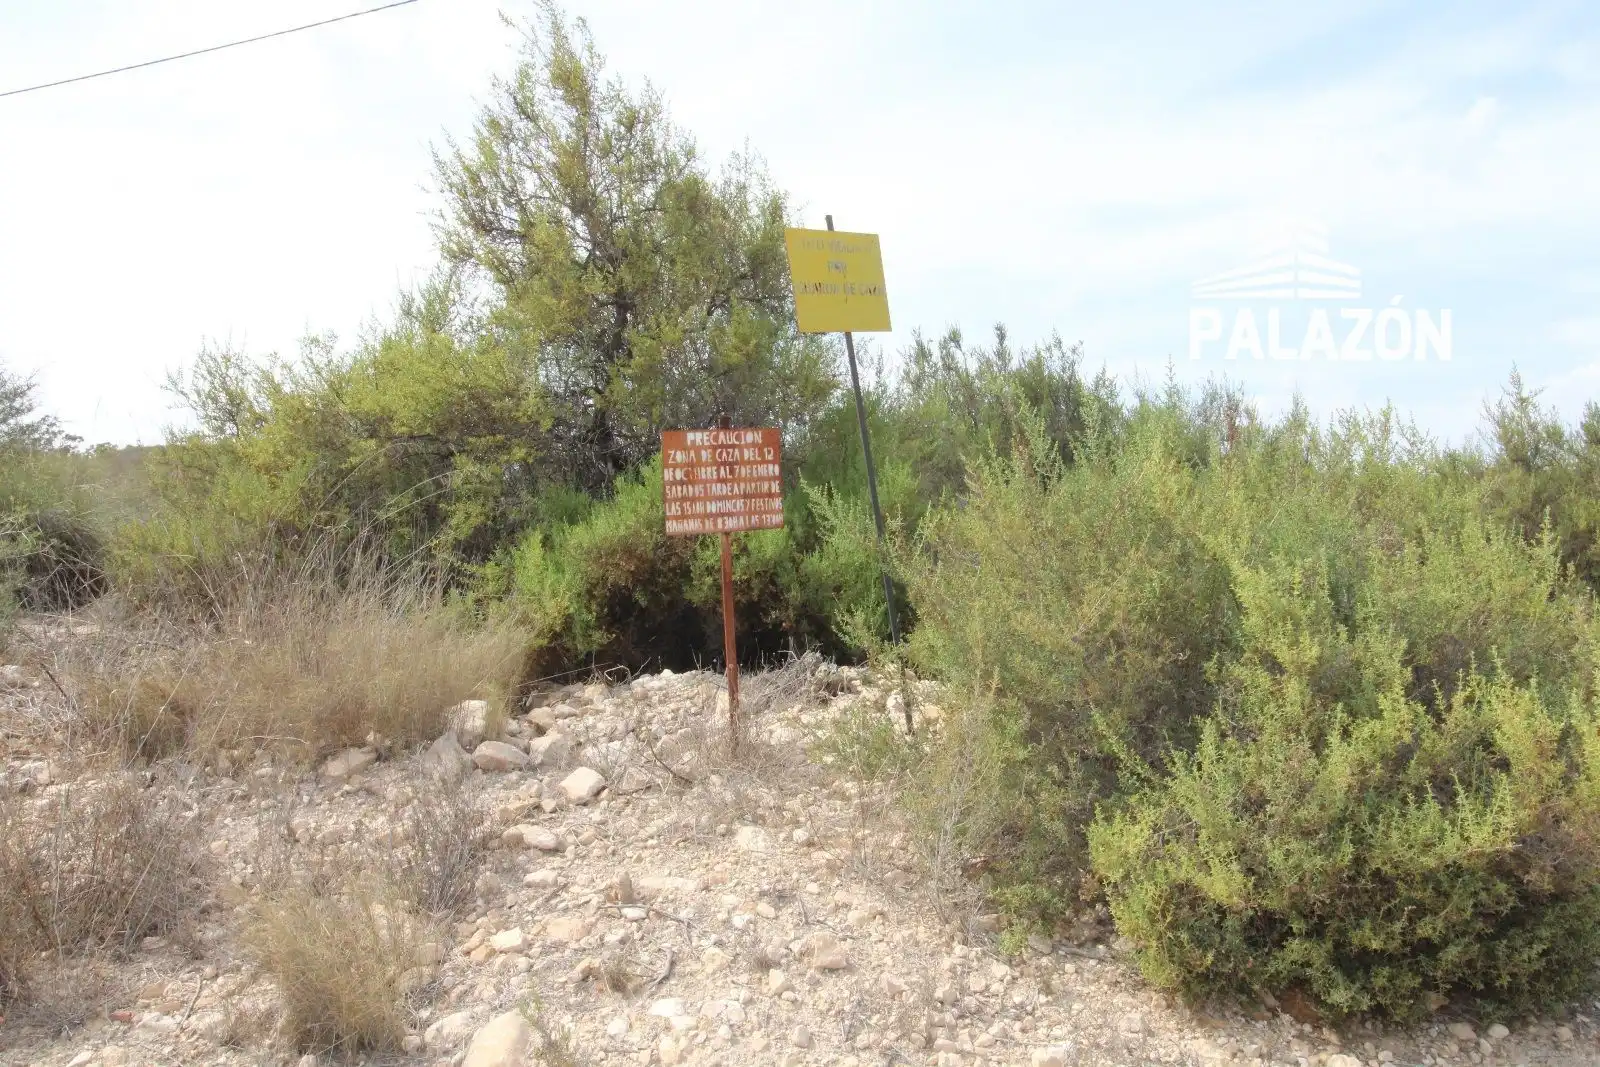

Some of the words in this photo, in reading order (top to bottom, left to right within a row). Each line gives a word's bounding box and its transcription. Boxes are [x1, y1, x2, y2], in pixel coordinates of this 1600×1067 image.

[687, 431, 762, 445] PRECAUCION
[668, 449, 696, 464] ZONA
[702, 449, 712, 462] DE
[716, 448, 740, 462] CAZA
[744, 448, 761, 460] DEL
[664, 468, 674, 481] DE
[720, 466, 732, 478] AL
[734, 466, 739, 477] 7
[740, 464, 750, 477] DE
[666, 484, 704, 498] SABADOS
[708, 482, 733, 496] TARDE
[733, 482, 739, 494] A
[740, 481, 770, 494] PARTIR
[771, 480, 780, 493] DE
[666, 502, 681, 516] LAS
[745, 499, 750, 510] Y
[704, 518, 714, 530] DE
